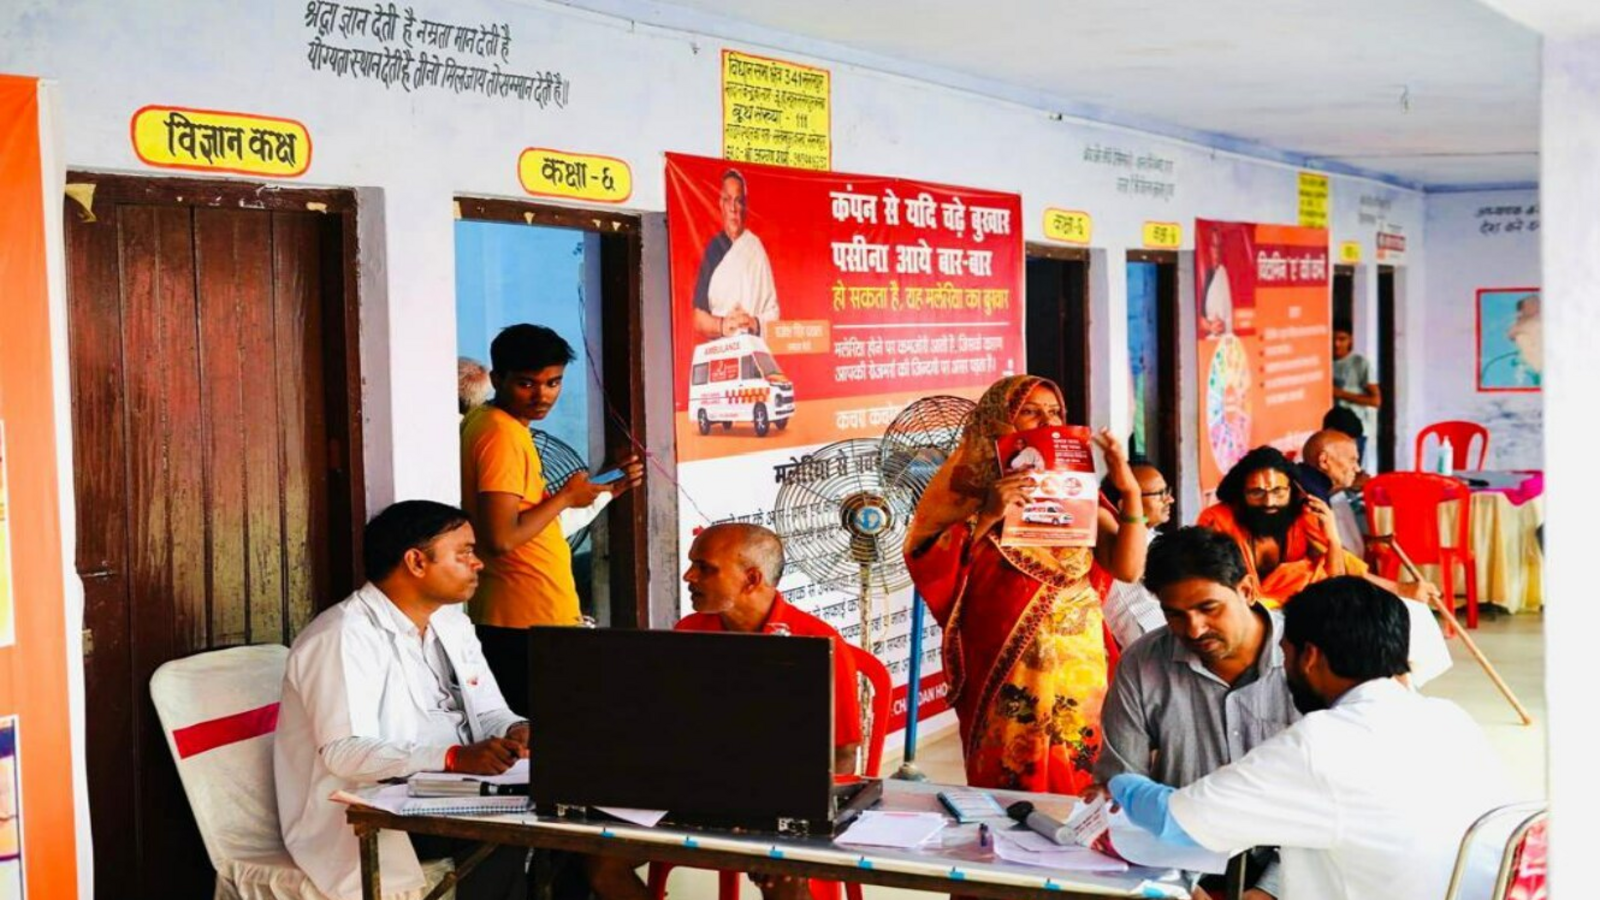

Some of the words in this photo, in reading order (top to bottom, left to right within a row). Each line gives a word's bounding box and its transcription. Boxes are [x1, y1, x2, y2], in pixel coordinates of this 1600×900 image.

[371, 3, 400, 43] देती
[402, 7, 417, 48] है
[476, 24, 498, 56] देती
[499, 24, 511, 63] है
[163, 112, 245, 165] विज्ञान
[248, 127, 298, 168] कक्ष
[829, 184, 878, 224] कंपन
[883, 188, 900, 226] से
[903, 192, 938, 229] यदि
[969, 206, 1011, 243] बुखार
[830, 235, 889, 273] पसीना
[895, 238, 933, 275] आये
[937, 247, 993, 276] बार-बार
[832, 280, 846, 311] हो
[848, 286, 887, 311] सकता
[905, 287, 924, 311] यह
[925, 281, 963, 309] मलेरिया
[965, 288, 980, 309] का
[982, 288, 1010, 316] बुखार
[773, 454, 832, 486] मलेरिया
